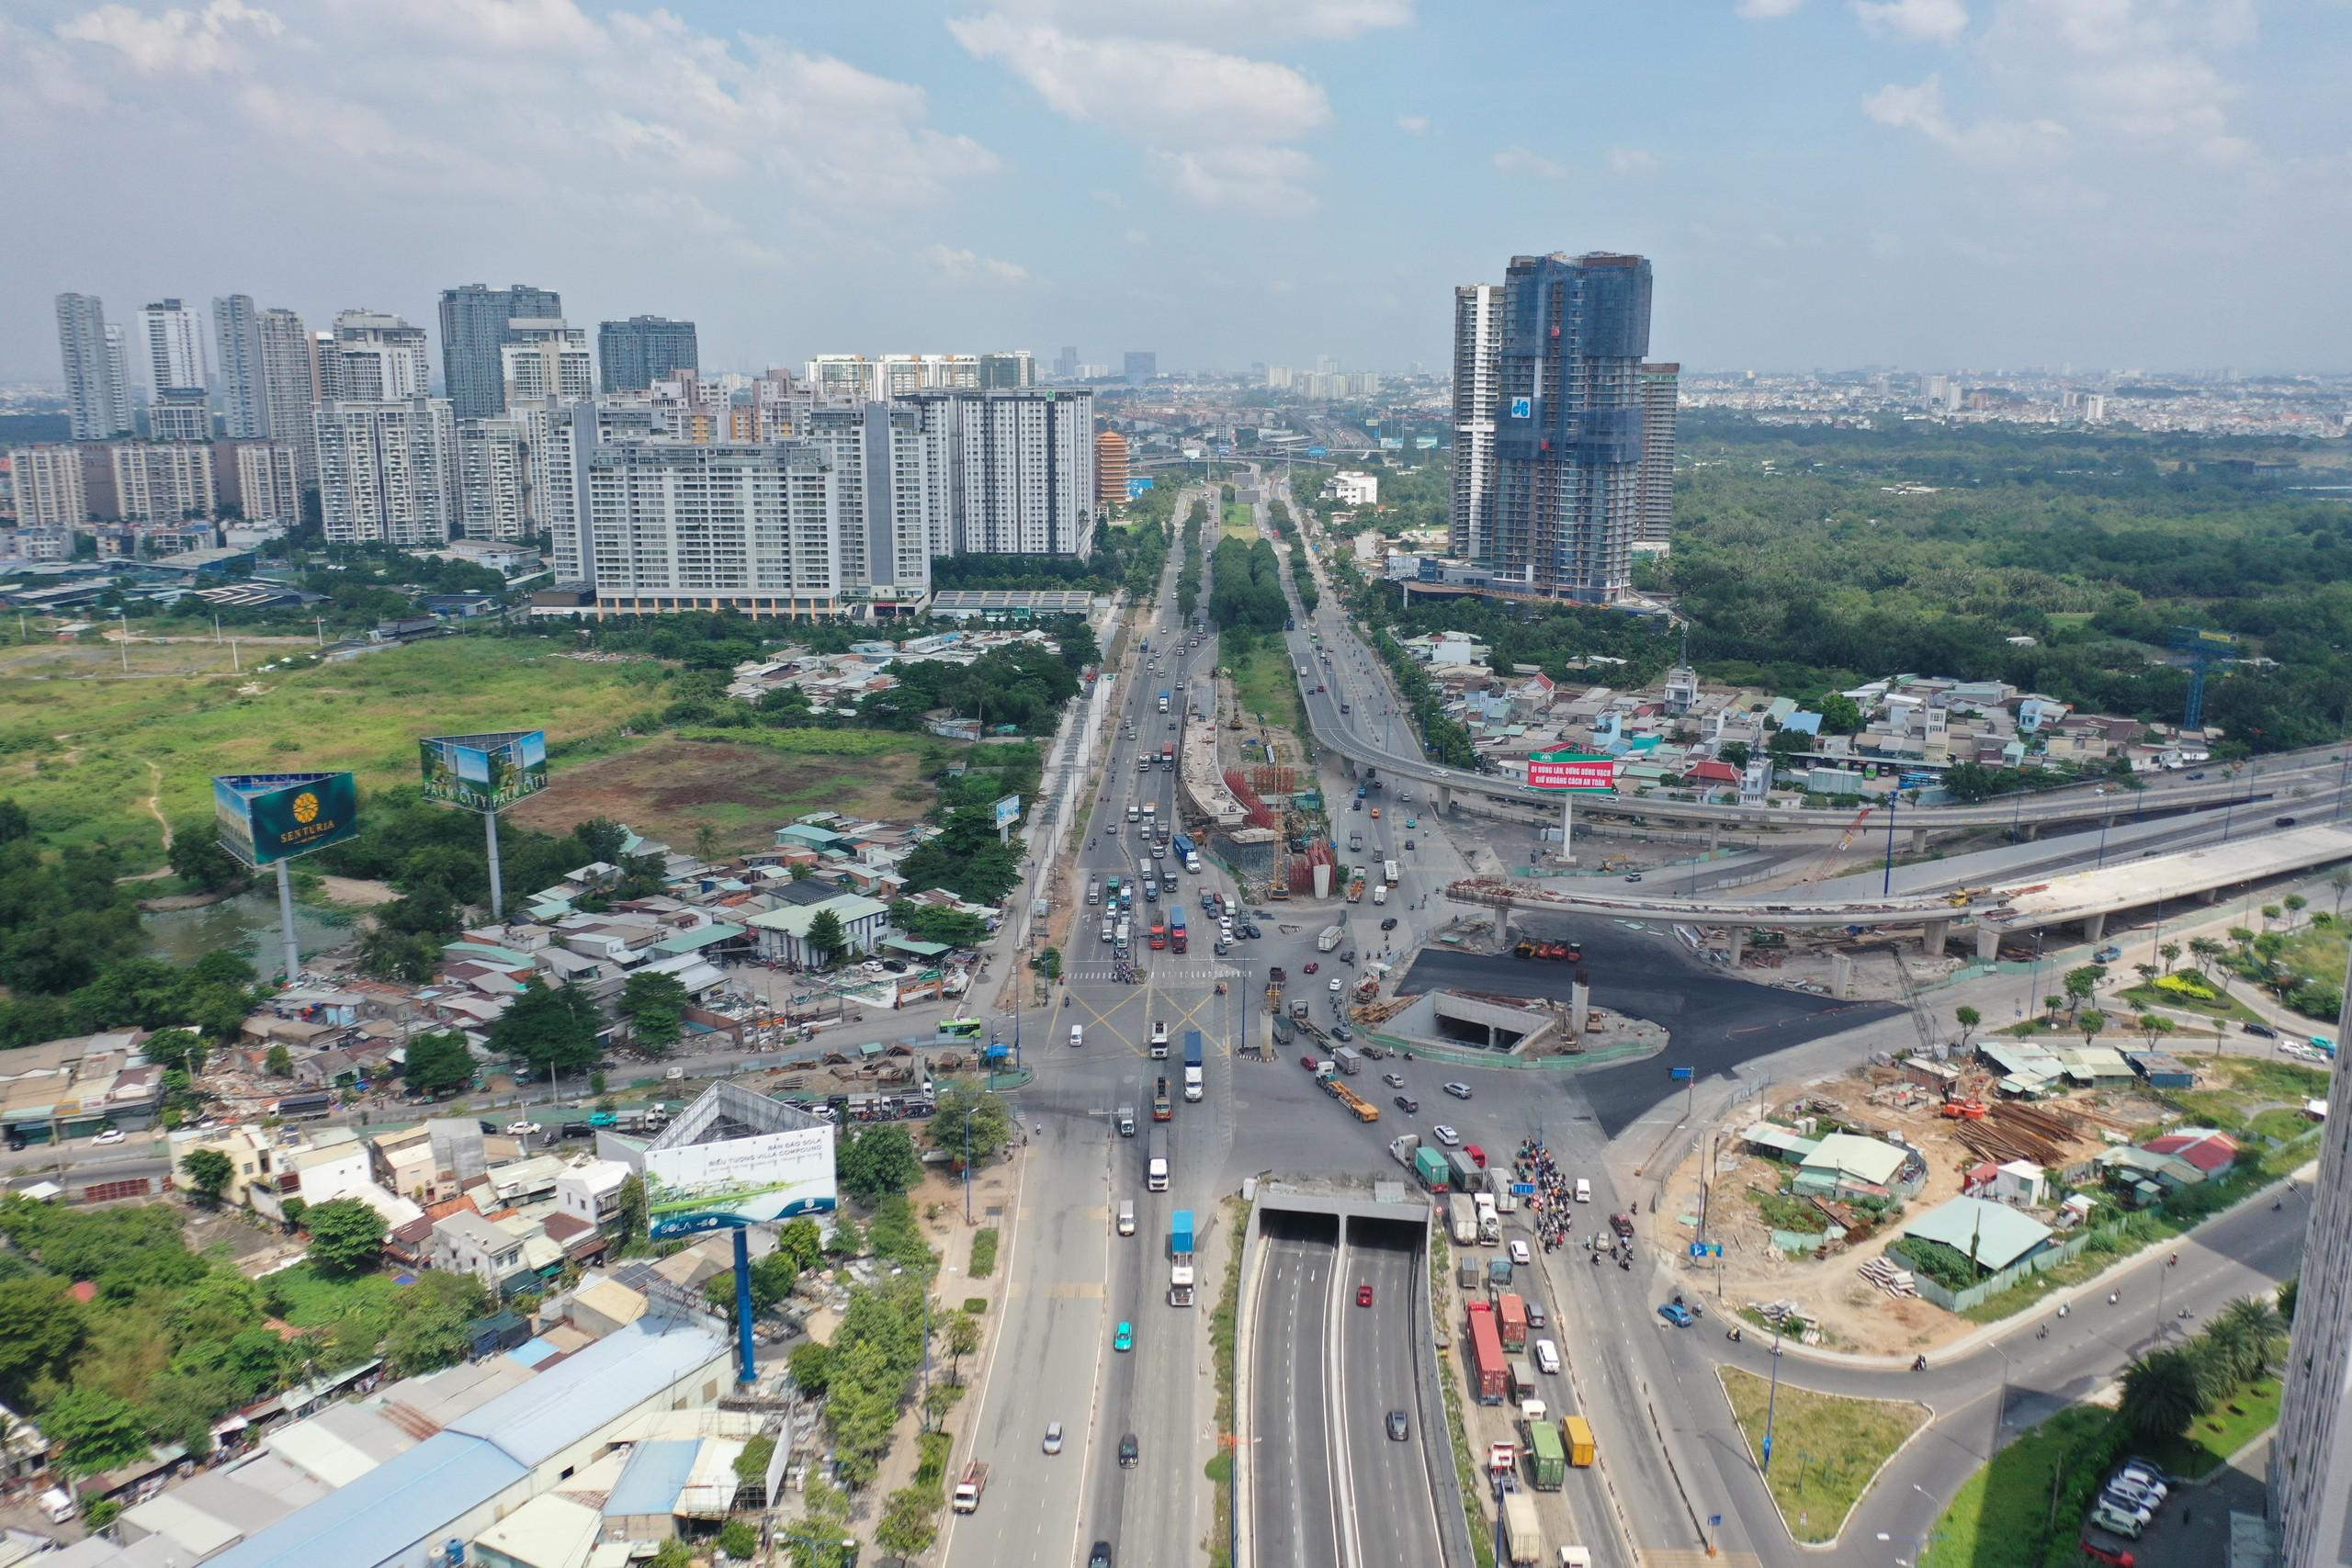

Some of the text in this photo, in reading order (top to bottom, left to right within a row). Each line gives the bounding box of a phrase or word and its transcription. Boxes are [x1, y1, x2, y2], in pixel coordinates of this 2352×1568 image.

[424, 782, 487, 808] PALM CITY
[492, 773, 546, 807] PALM CITY
[280, 819, 335, 843] SENTURIA
[757, 1152, 776, 1161] VILLA
[778, 1145, 822, 1156] COMPOUND
